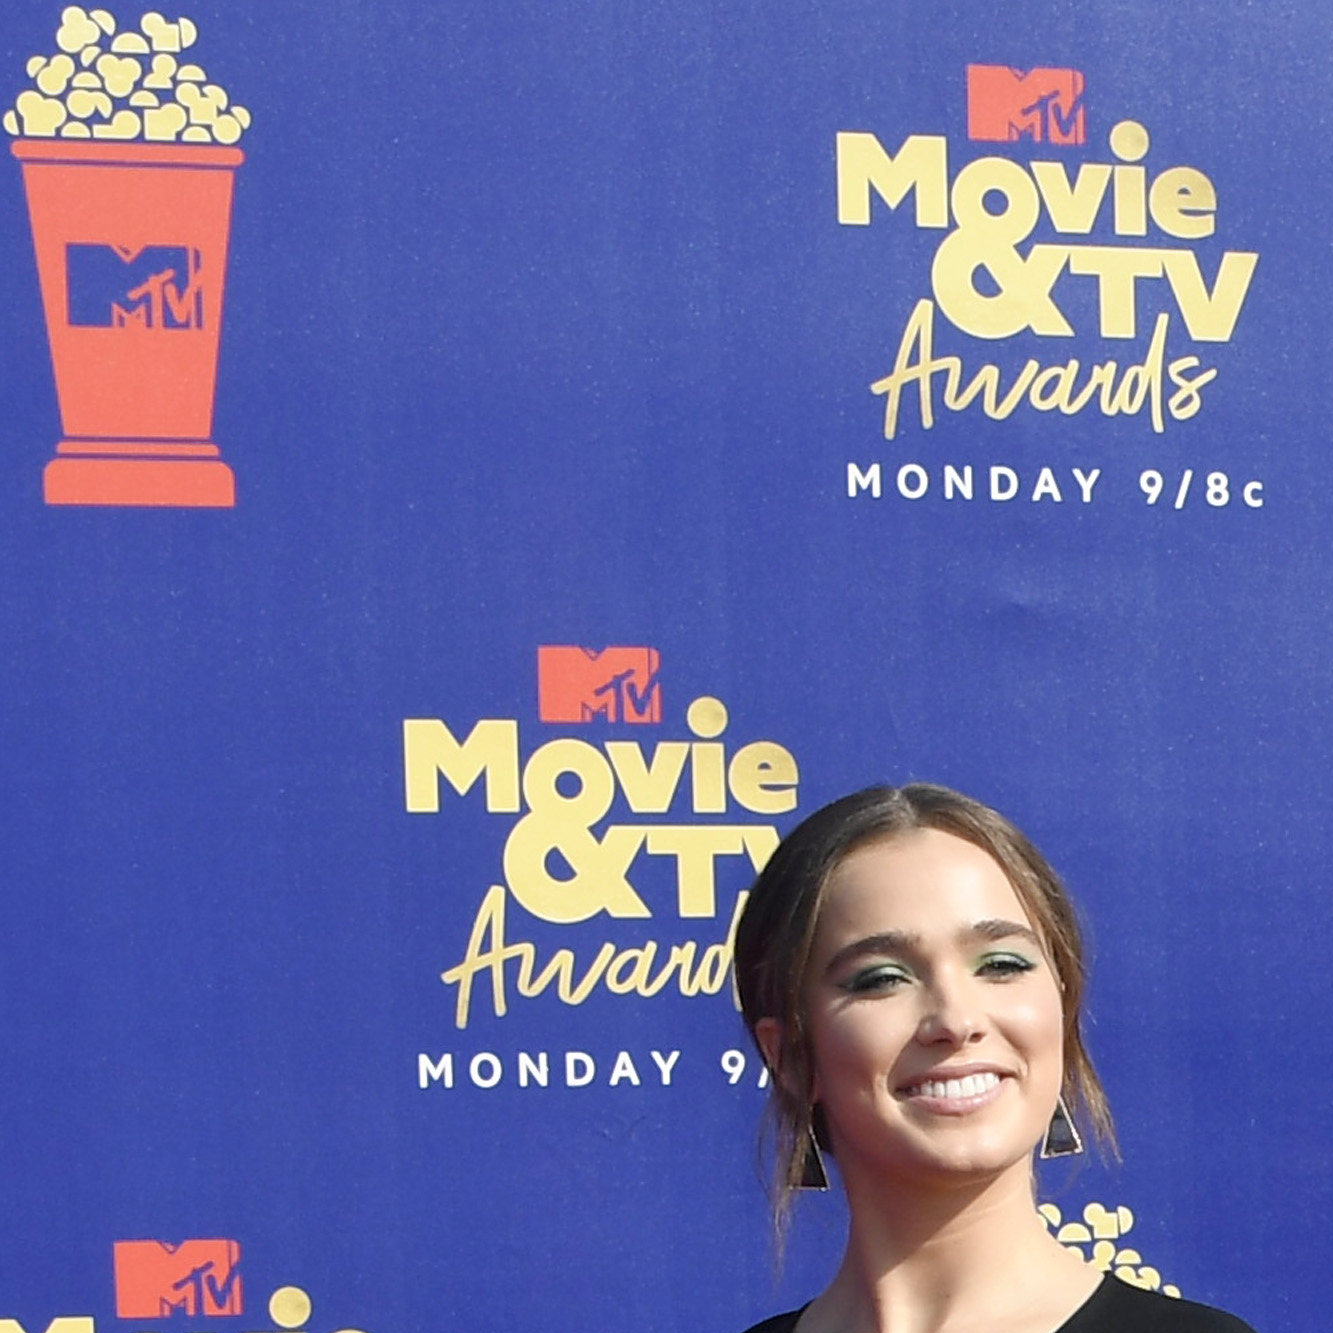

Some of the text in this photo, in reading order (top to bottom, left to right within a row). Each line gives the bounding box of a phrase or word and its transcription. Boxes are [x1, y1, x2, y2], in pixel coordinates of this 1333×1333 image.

[967, 64, 1086, 145] MTV
[836, 120, 1217, 240] Movie
[65, 243, 205, 328] MTV
[869, 298, 1217, 440] Awards
[846, 462, 1264, 509] MONDAY 9/8c
[537, 644, 662, 724] MTV
[403, 696, 799, 814] Movie
[441, 885, 750, 1029] Award
[418, 1050, 681, 1089] MONDAY
[113, 1238, 243, 1319] MTV
